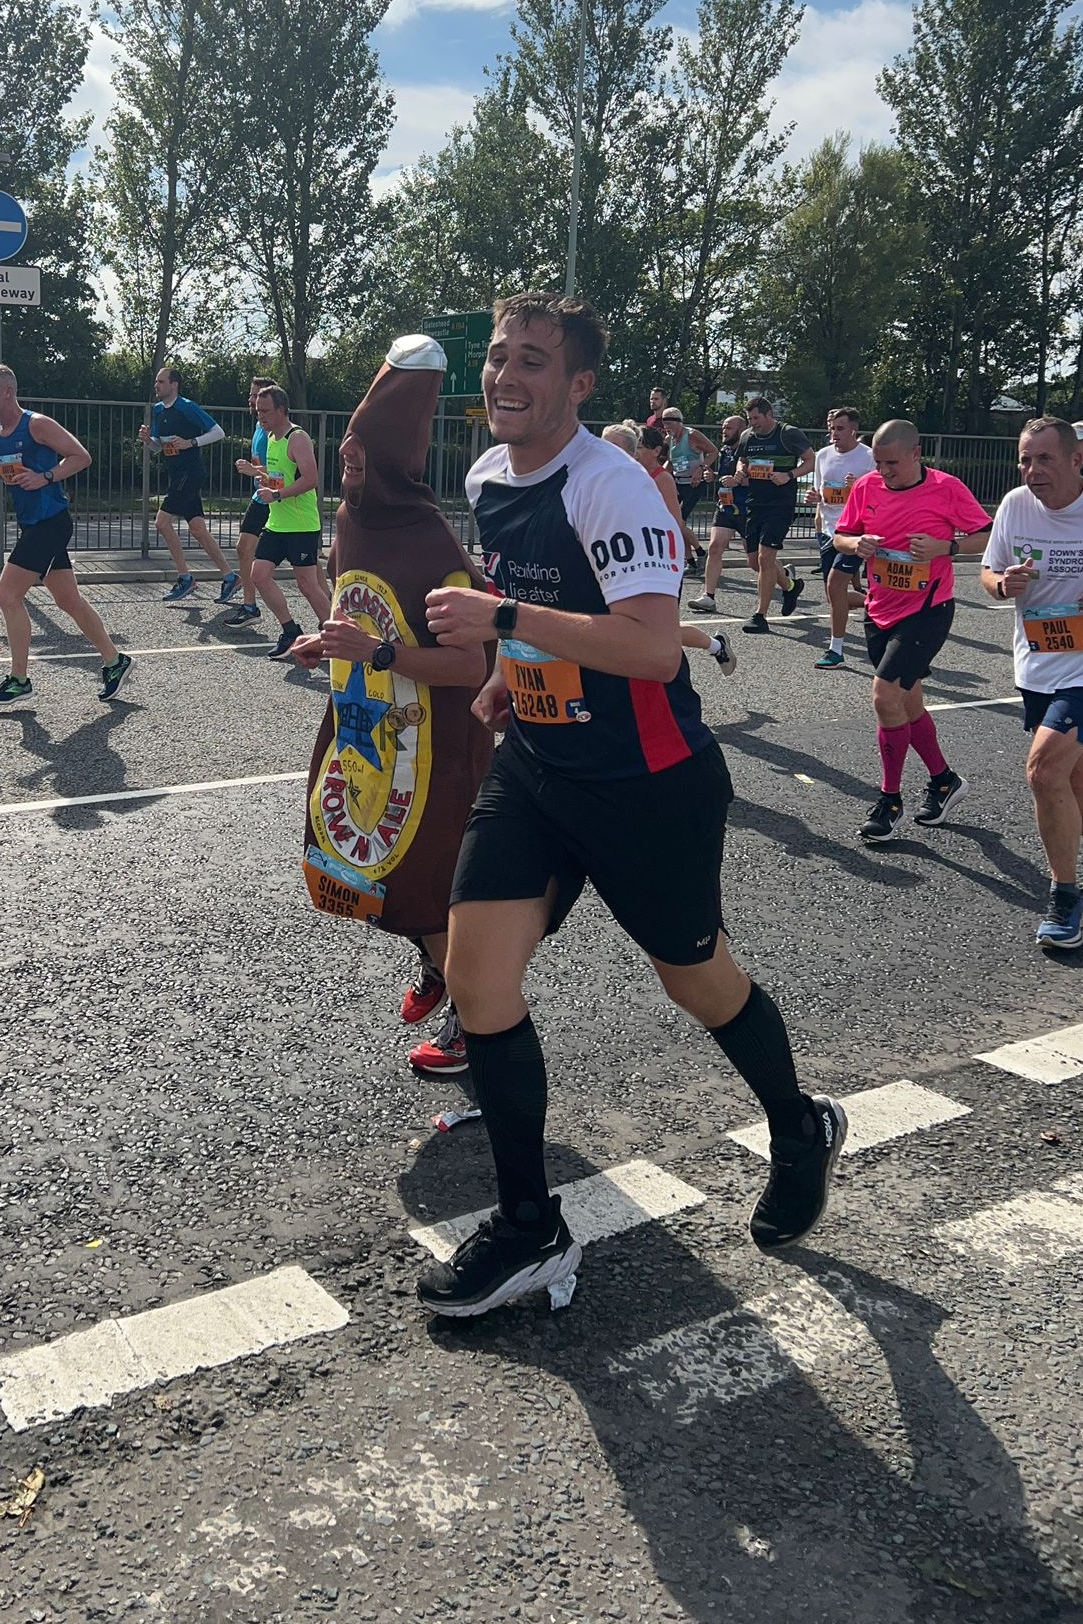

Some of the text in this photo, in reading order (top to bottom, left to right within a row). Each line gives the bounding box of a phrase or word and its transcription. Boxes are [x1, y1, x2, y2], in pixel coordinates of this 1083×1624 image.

[468, 350, 488, 359] Morpet
[590, 531, 635, 571] DO
[1049, 549, 1083, 557] DOWN'S
[599, 561, 671, 583] FOR VETERANS
[886, 562, 914, 577] ADAM
[887, 574, 911, 589] 7205
[1042, 619, 1071, 635] PAUL
[1045, 634, 1075, 650] 2540
[514, 690, 559, 719] 15248
[376, 788, 413, 848] ALE
[318, 875, 360, 906] SIMON
[318, 894, 354, 917] 3355
[822, 1111, 833, 1147] HOKA
